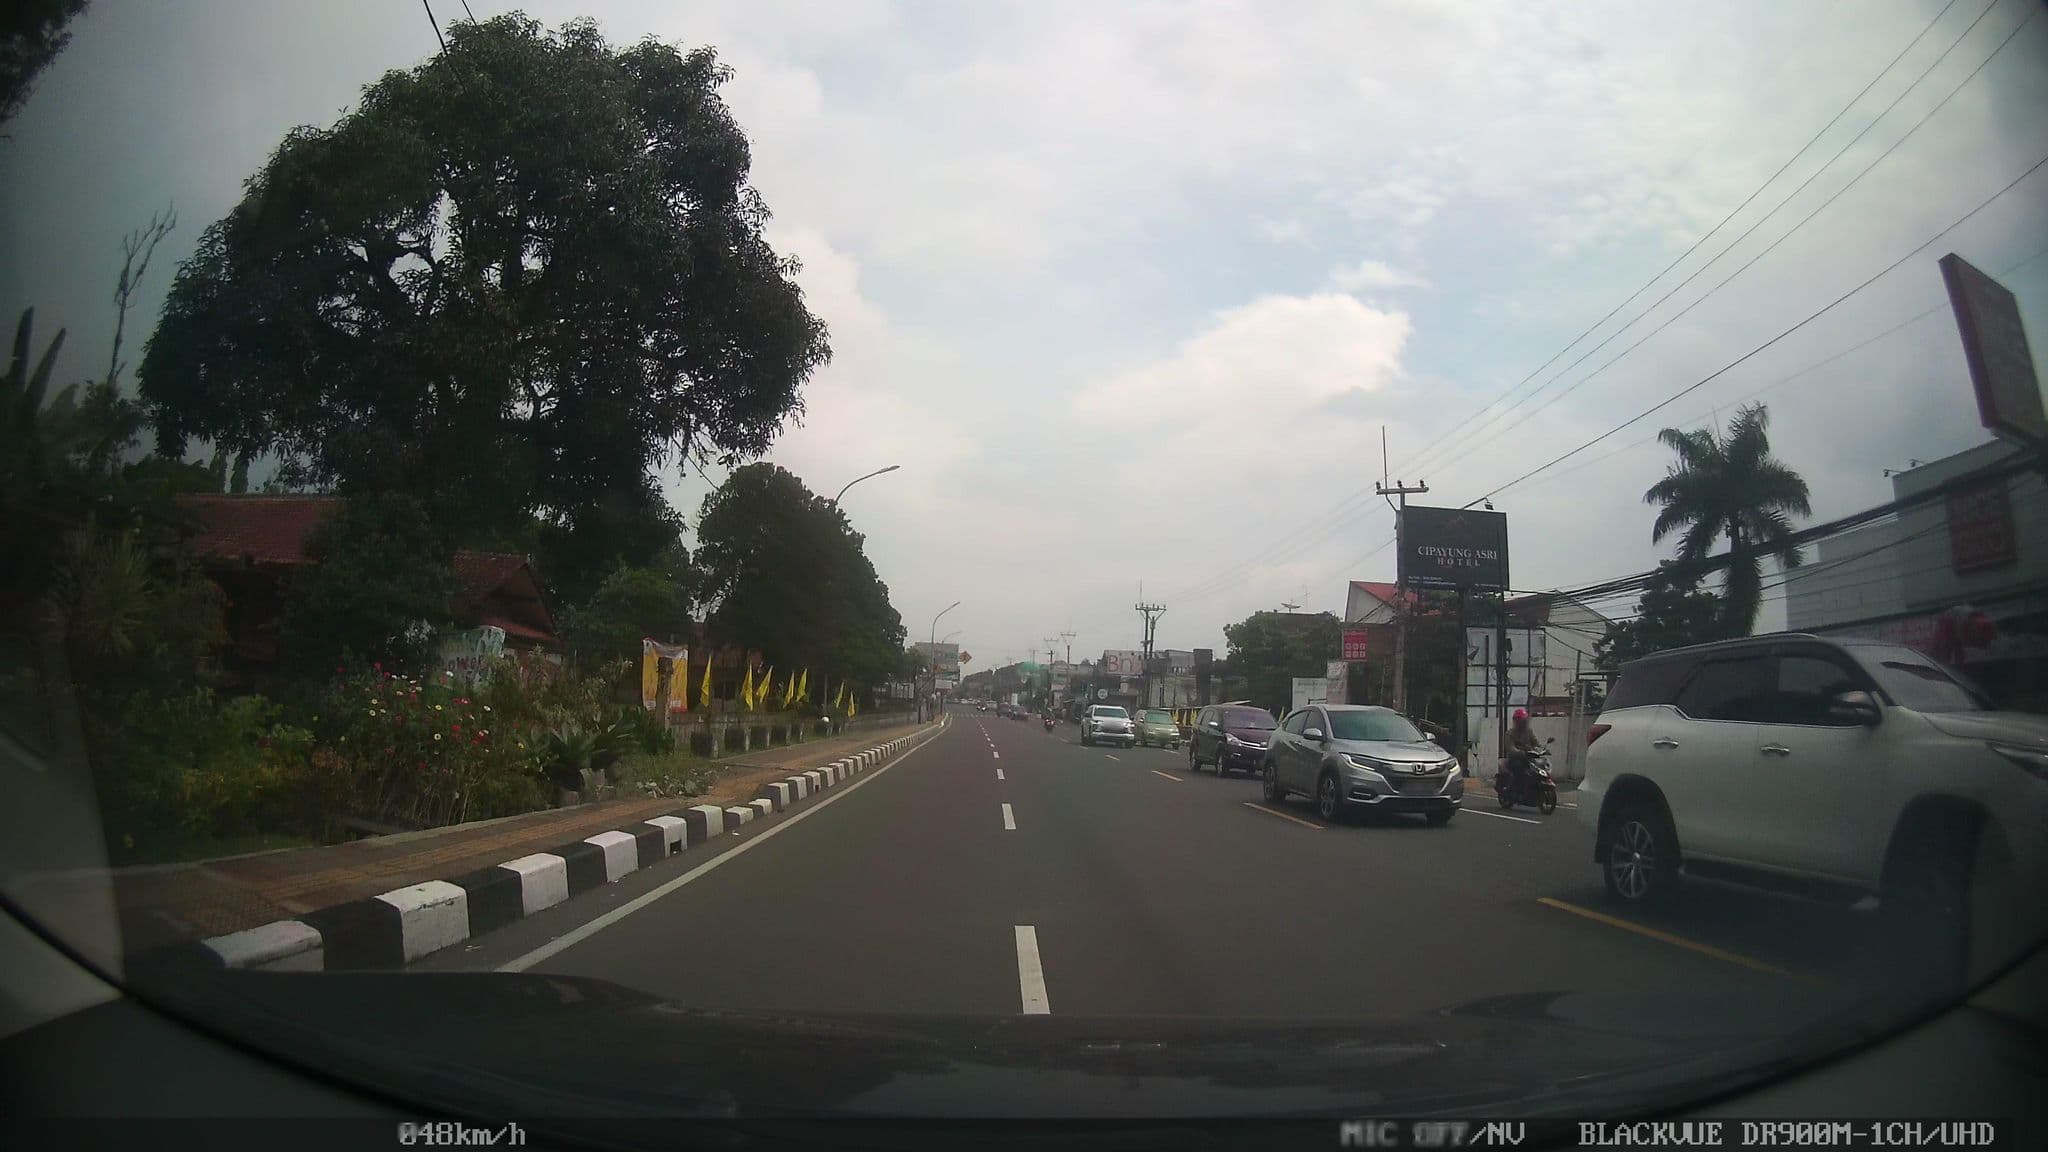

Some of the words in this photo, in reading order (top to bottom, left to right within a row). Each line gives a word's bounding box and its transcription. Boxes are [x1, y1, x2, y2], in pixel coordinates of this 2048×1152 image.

[1417, 546, 1472, 558] CIPAYUNG
[1475, 550, 1498, 560] ASRI
[1437, 557, 1481, 567] HOTEL
